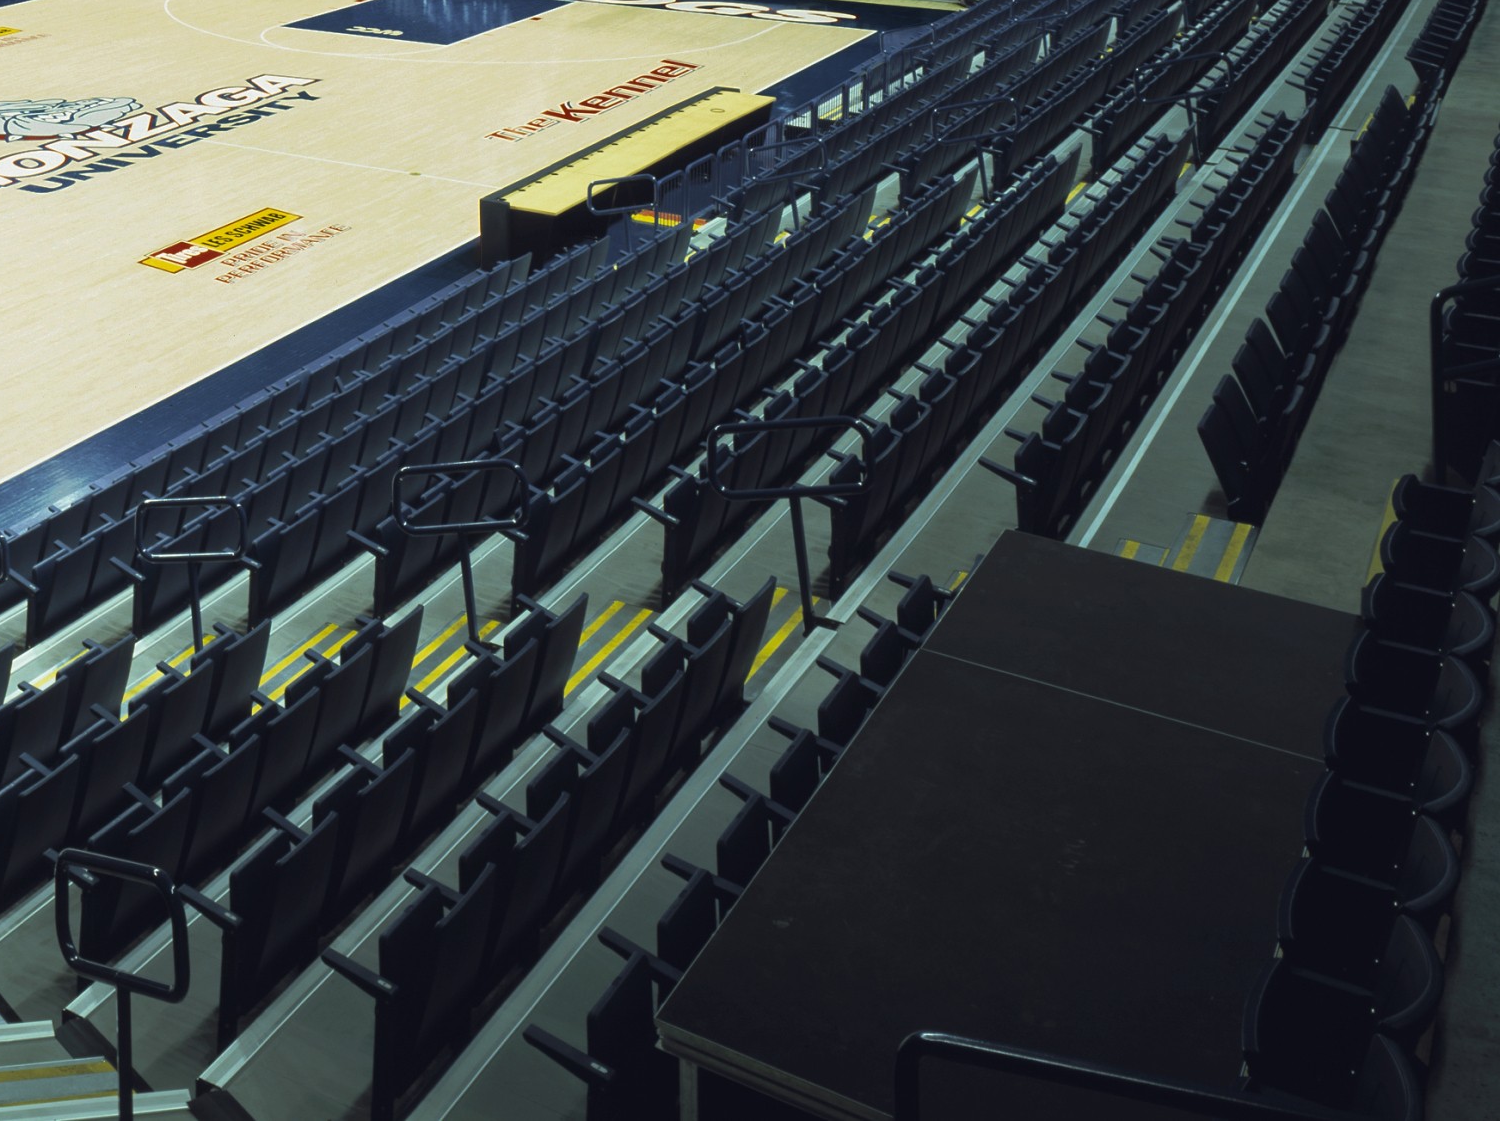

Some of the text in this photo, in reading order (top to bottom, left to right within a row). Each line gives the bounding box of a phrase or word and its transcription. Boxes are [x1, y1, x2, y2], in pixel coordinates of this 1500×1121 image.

[484, 58, 705, 143] The Kennel
[19, 90, 321, 193] UNIVERSITY
[157, 213, 287, 263] Tires LES SCHWAB
[215, 224, 352, 284] PERFORMANCE
[220, 239, 282, 268] PRIDE
